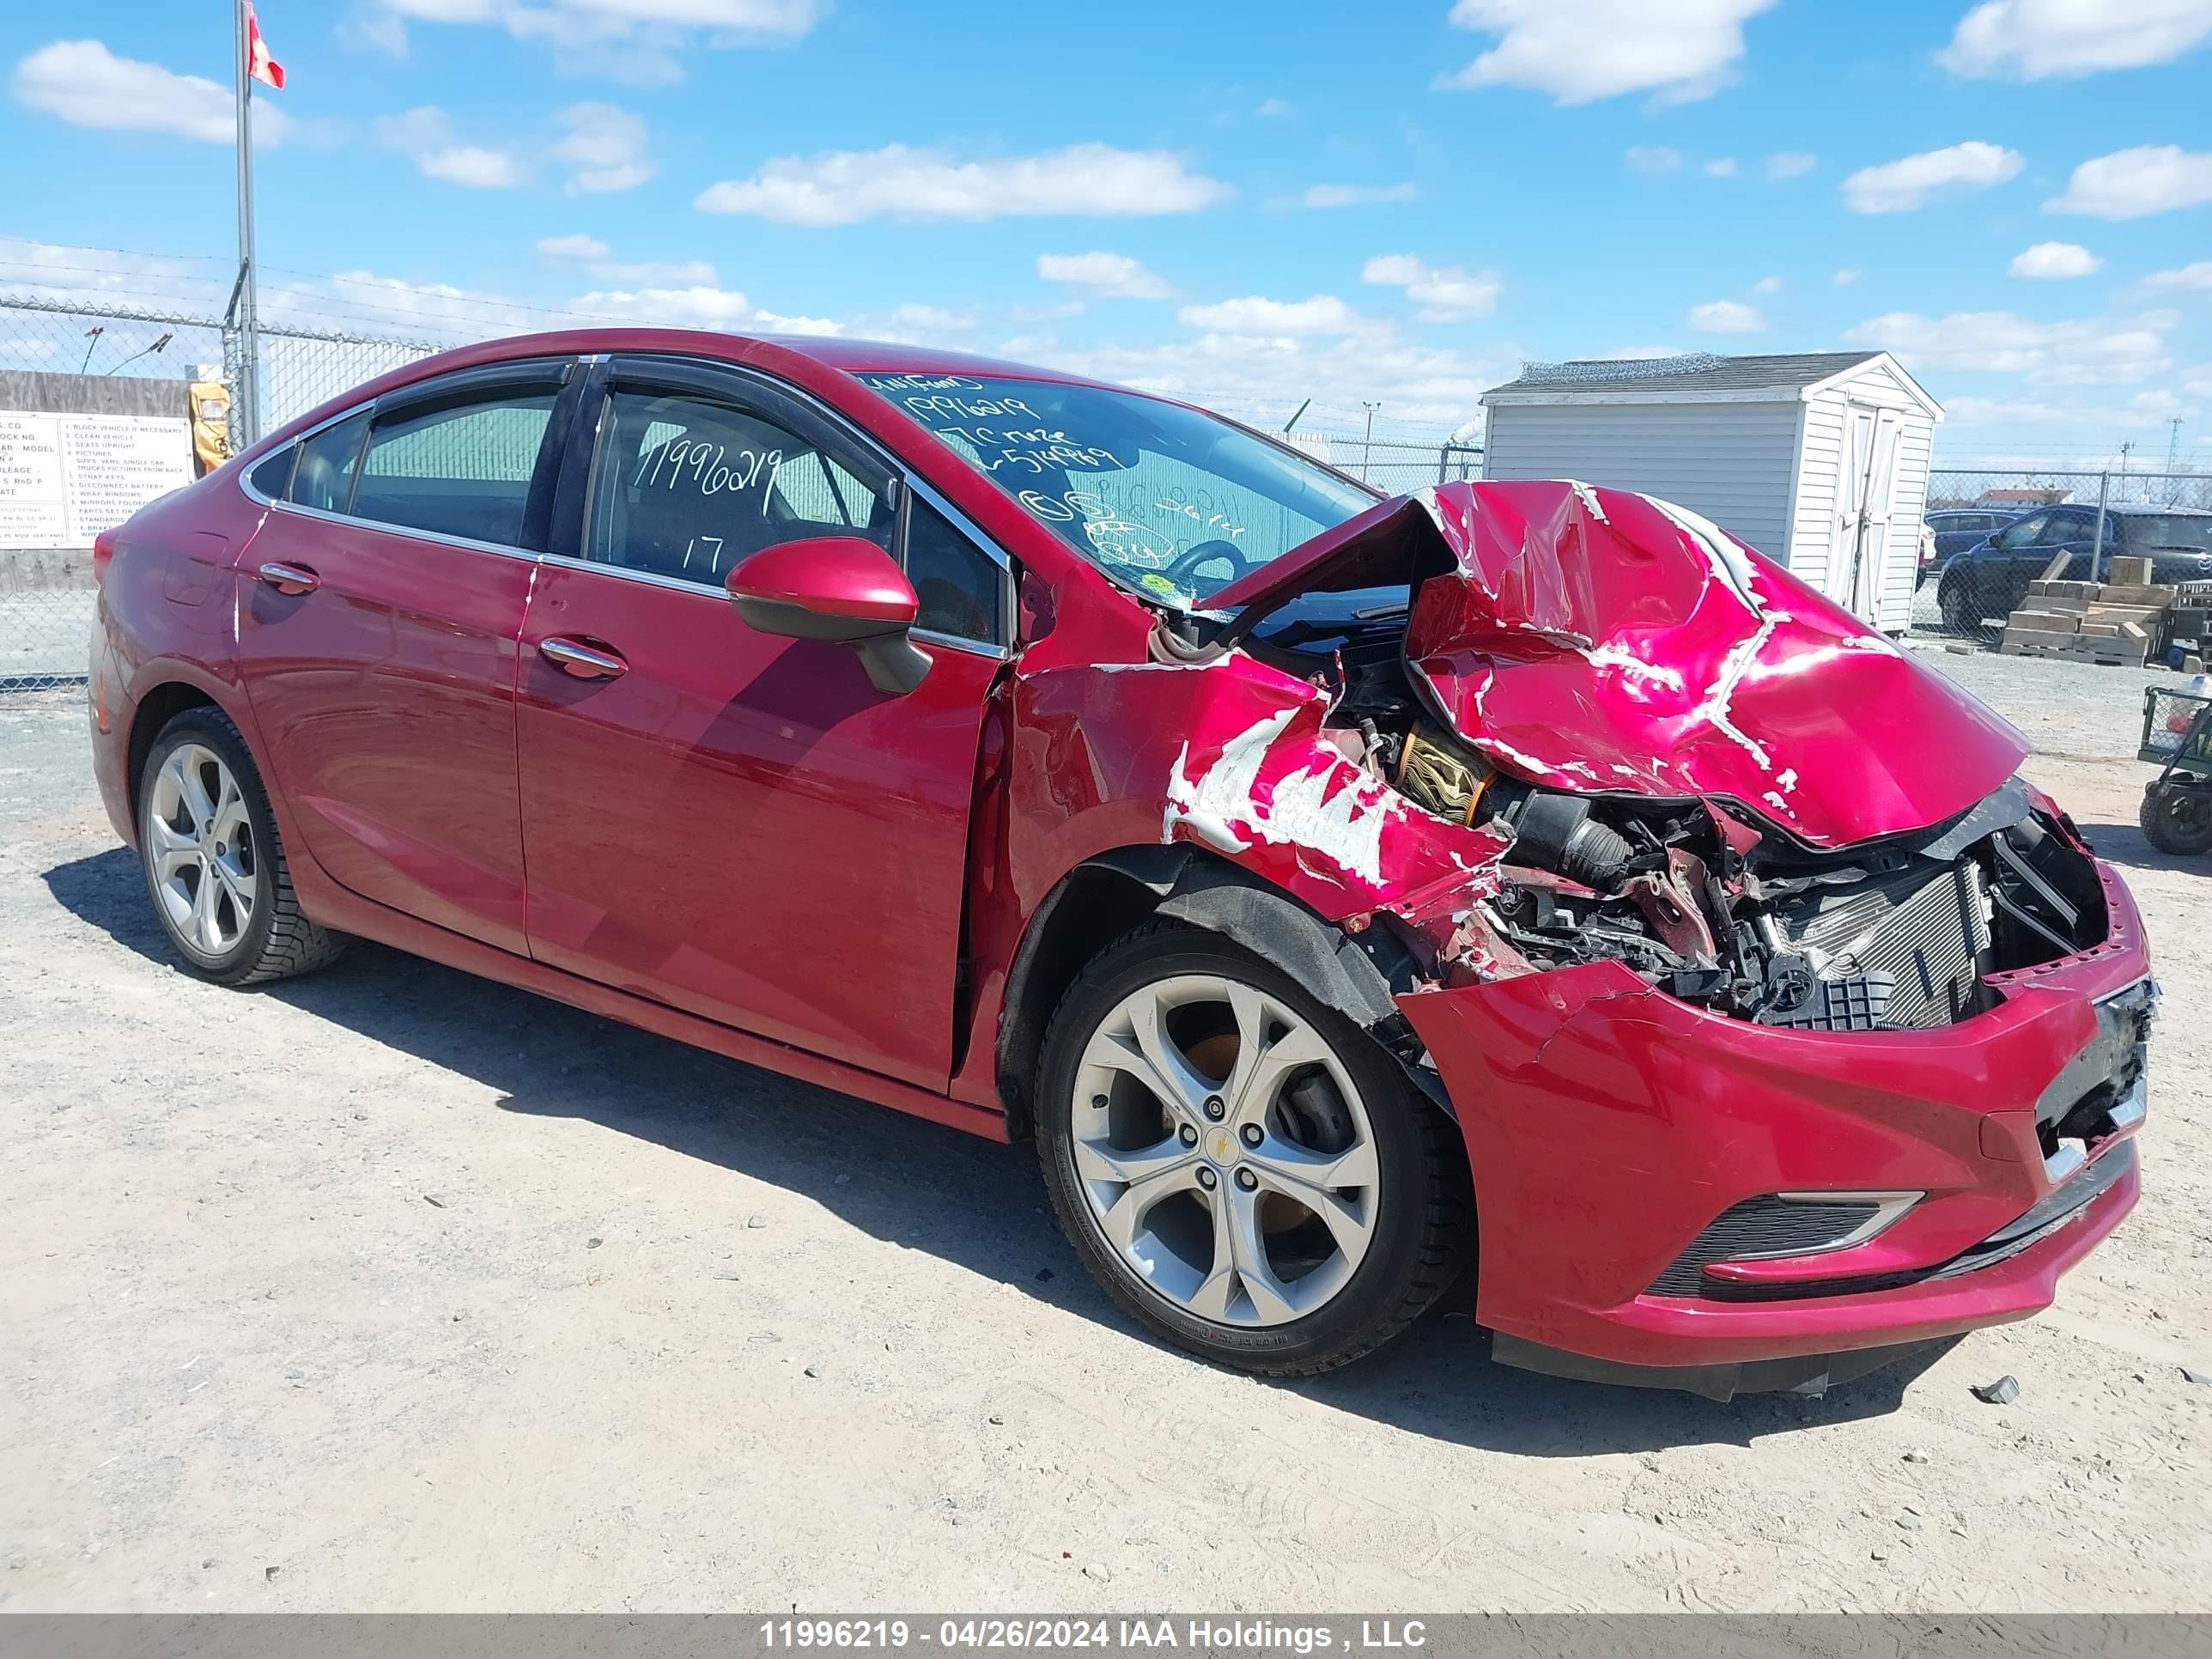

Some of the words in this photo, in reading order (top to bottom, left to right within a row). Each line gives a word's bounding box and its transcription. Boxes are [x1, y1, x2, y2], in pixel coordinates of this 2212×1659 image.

[903, 396, 1042, 422] 1996219
[22, 445, 55, 453] MODEL
[644, 439, 783, 517] 11996219
[683, 536, 724, 574] 17
